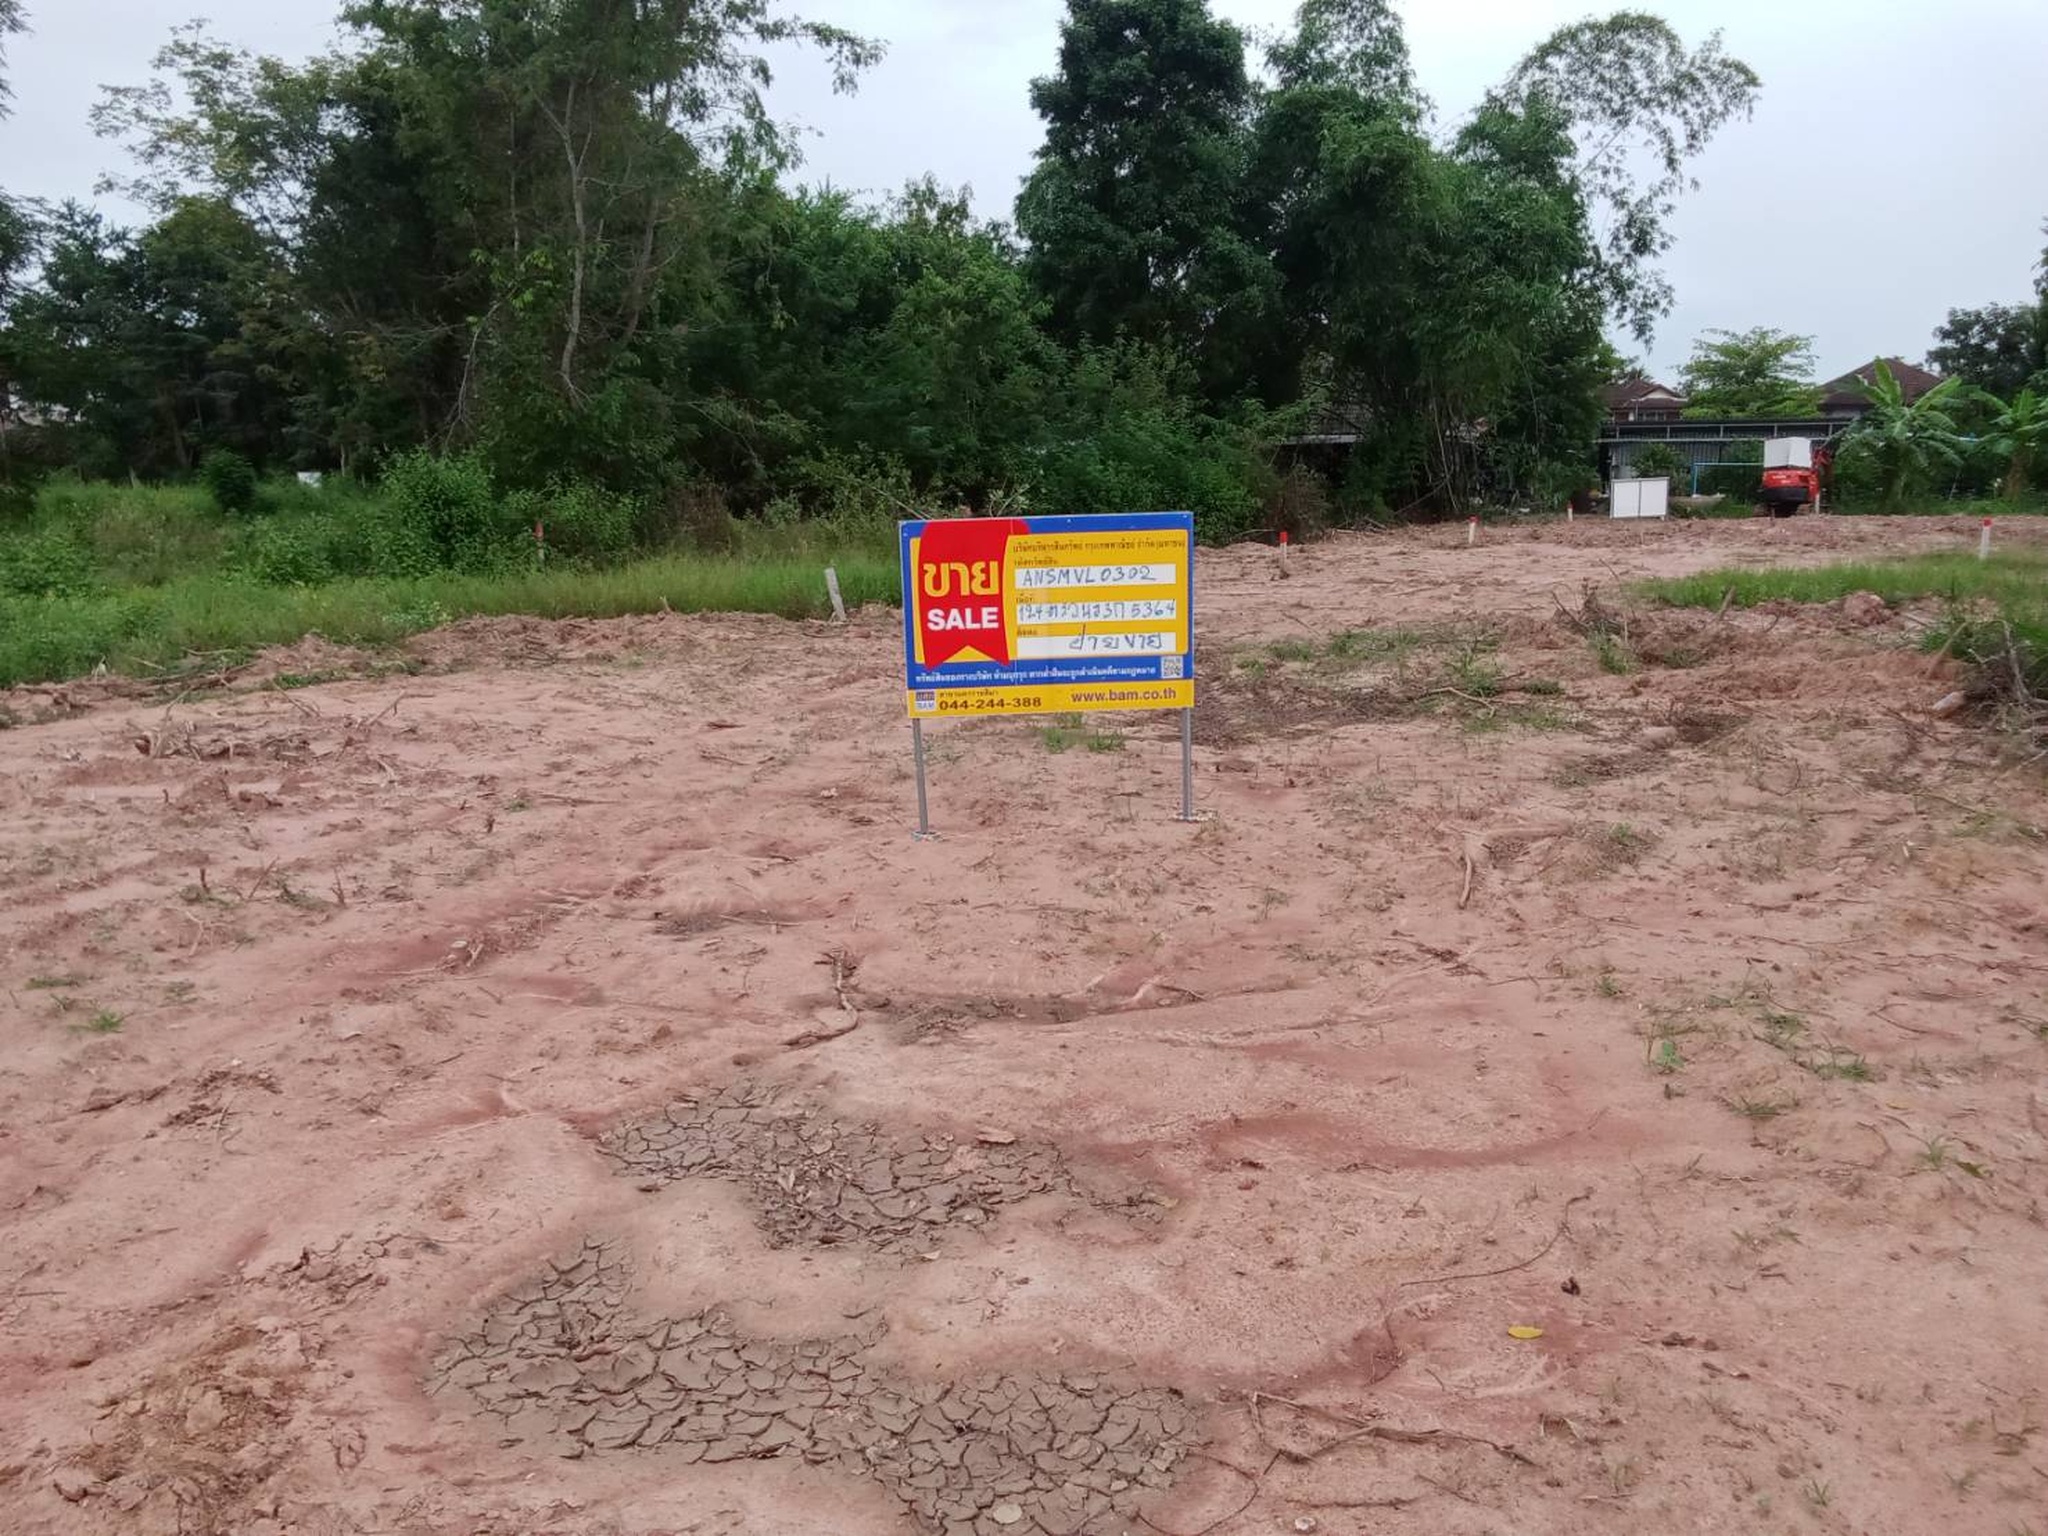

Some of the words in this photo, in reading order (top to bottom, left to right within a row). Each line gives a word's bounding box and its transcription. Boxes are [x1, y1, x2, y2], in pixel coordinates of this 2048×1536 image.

[923, 560, 1000, 597] ขาย
[1131, 598, 1175, 618] 5364
[927, 606, 999, 631] SALE
[939, 697, 1042, 711] 044-244-388
[1071, 687, 1177, 702] www.bam.co.th
